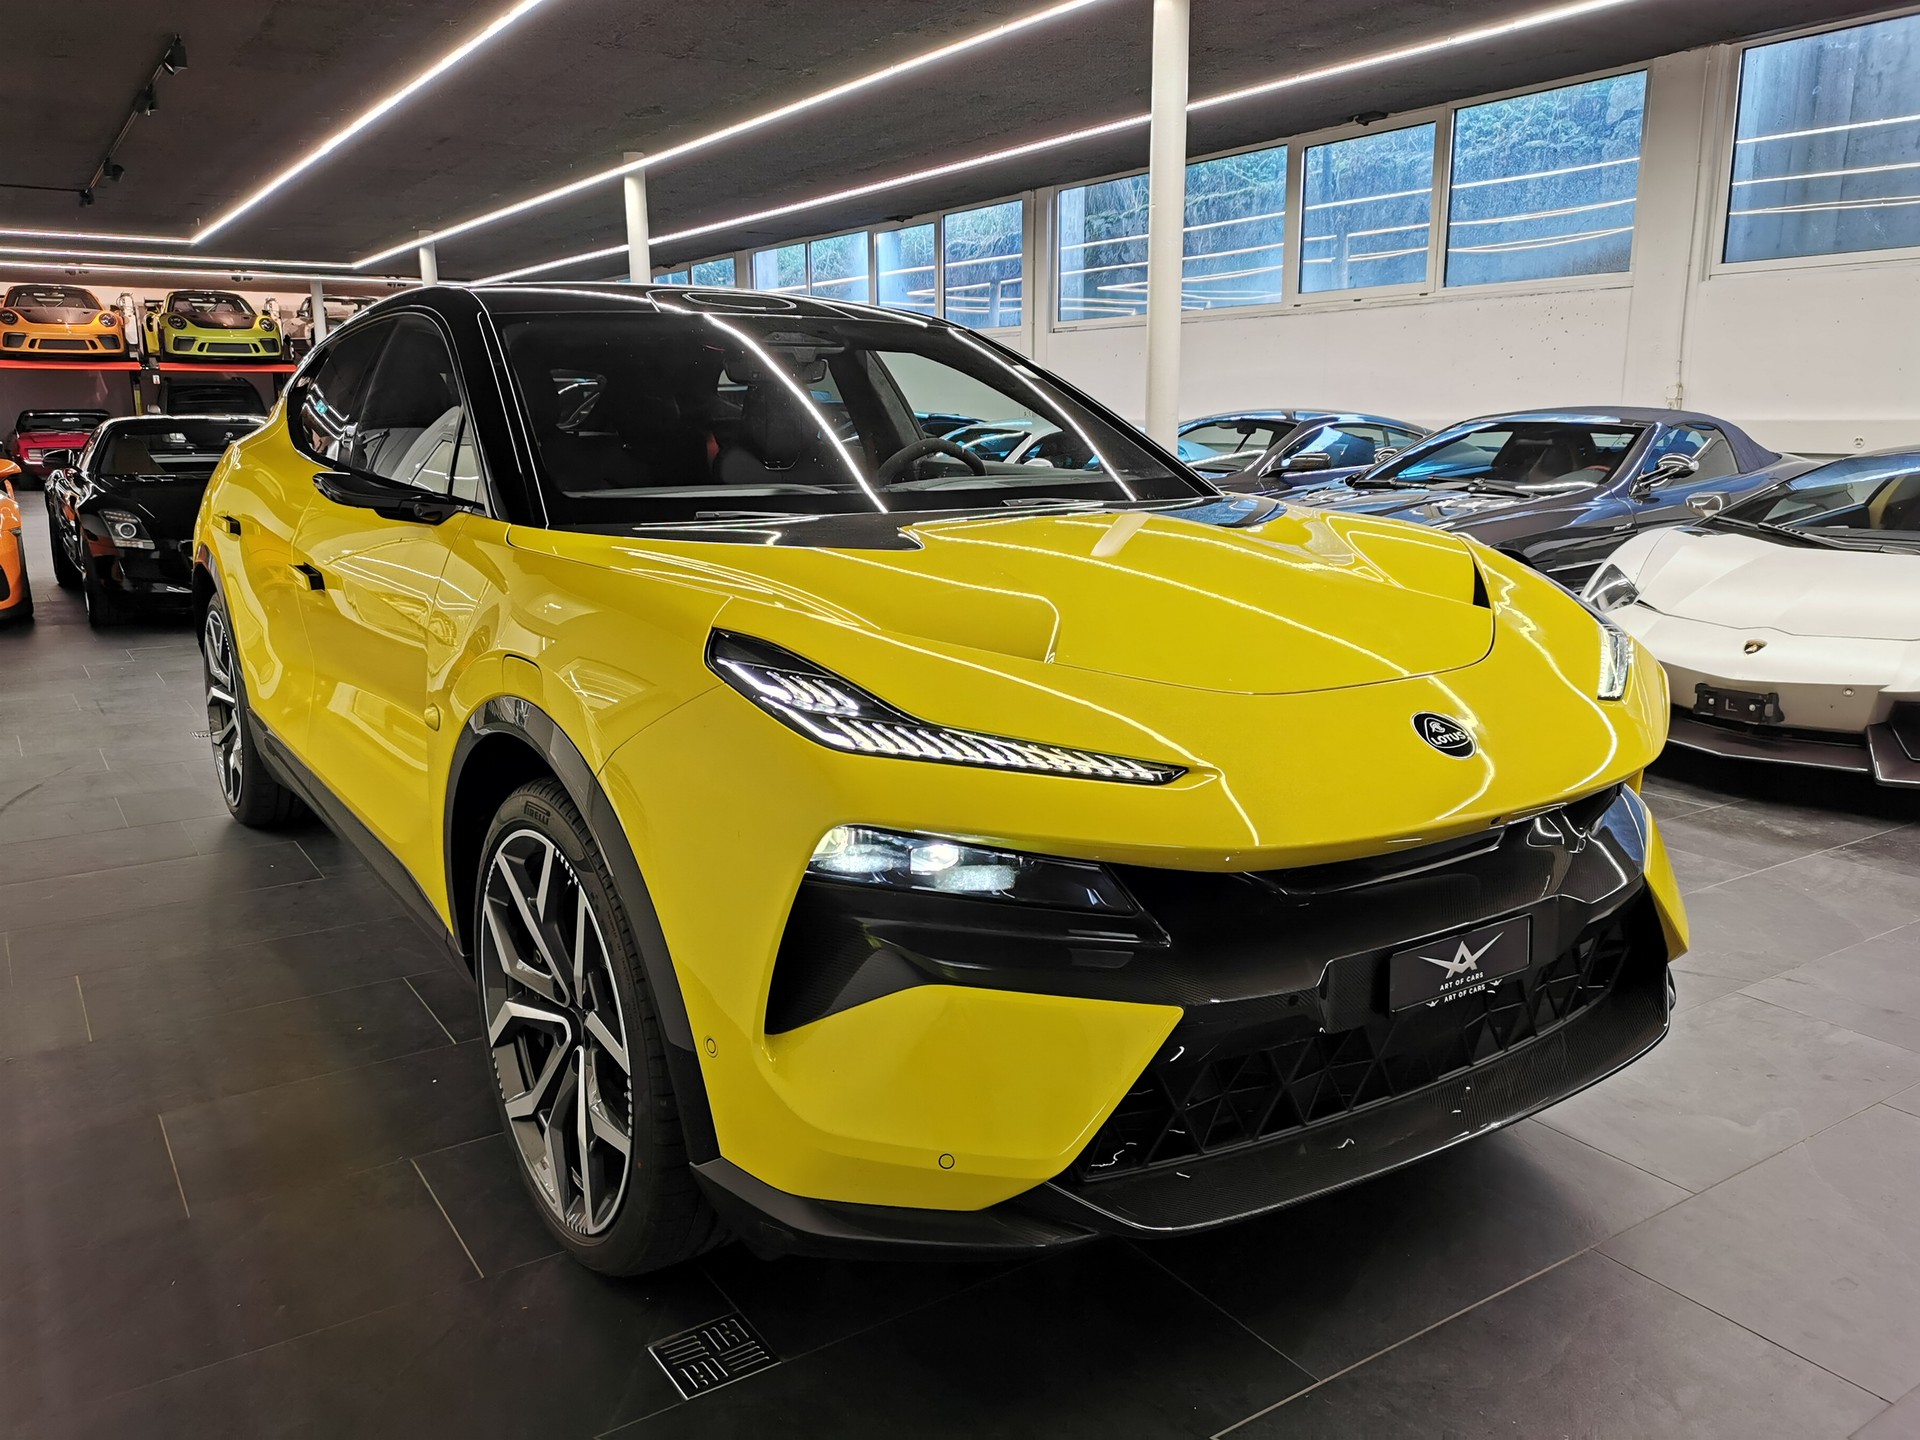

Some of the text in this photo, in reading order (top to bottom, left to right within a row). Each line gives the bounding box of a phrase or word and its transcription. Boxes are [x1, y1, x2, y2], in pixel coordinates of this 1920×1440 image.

[1431, 731, 1466, 745] LOTUS
[524, 800, 551, 826] PIRELLI
[1440, 971, 1484, 991] ART OF CARS
[1444, 984, 1486, 1003] ART OF CARS
